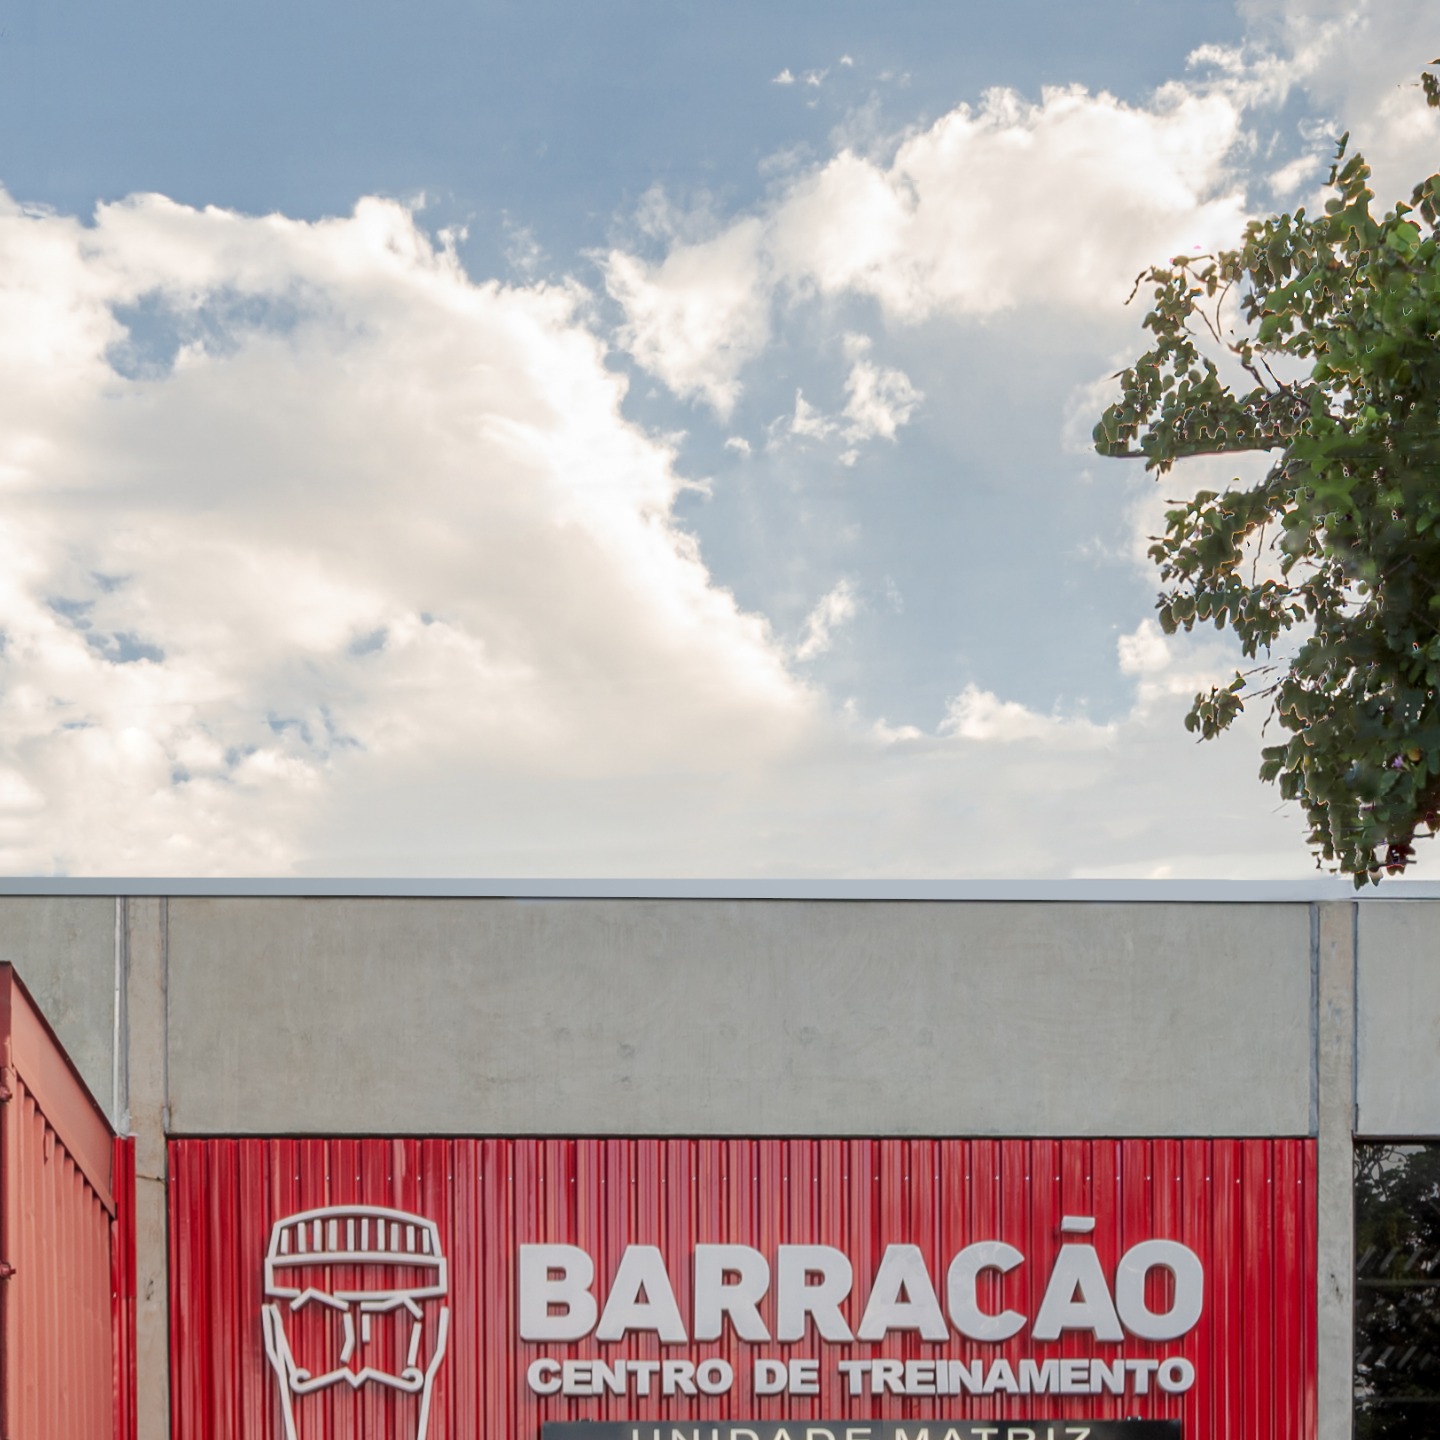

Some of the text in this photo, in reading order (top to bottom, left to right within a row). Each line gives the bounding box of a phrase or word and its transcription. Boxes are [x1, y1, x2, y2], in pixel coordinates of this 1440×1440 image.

[519, 1215, 1204, 1344] BARRACÃO
[526, 1357, 1196, 1396] CENTRO DE TREINAMENTO
